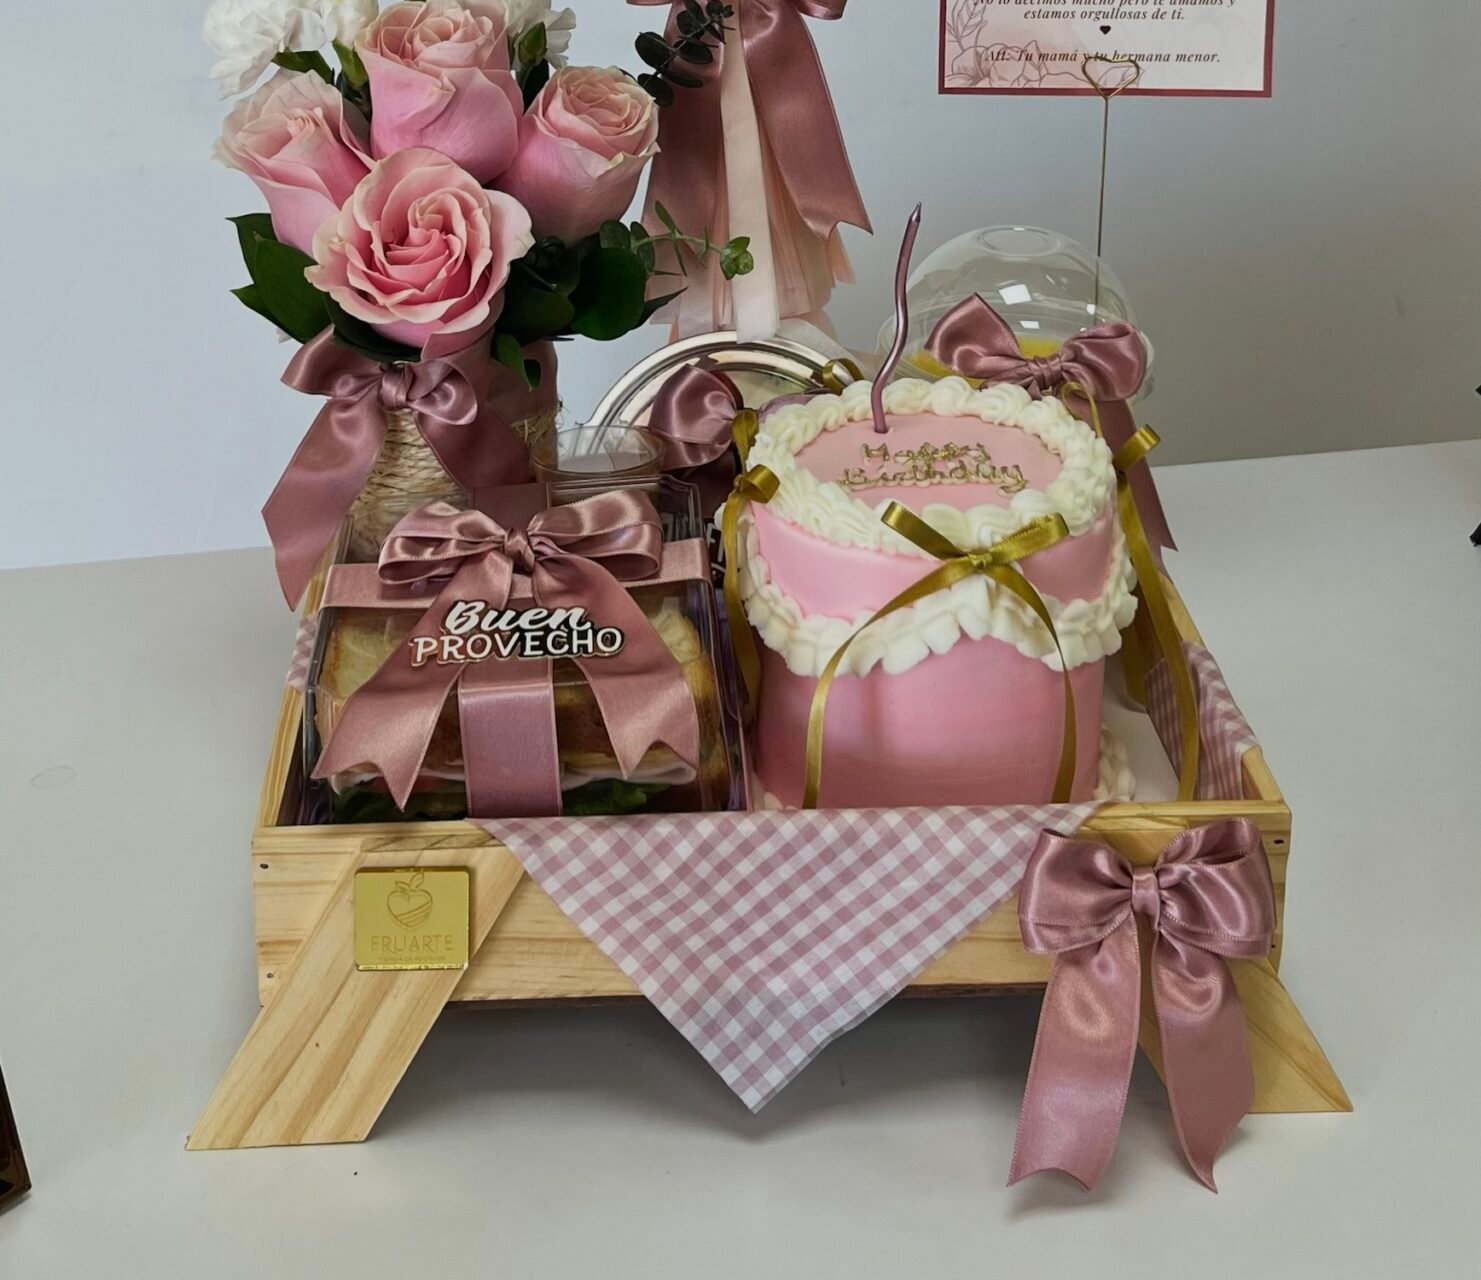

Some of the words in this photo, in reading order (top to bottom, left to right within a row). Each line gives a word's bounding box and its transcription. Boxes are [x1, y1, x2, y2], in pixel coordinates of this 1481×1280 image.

[1024, 8, 1076, 19] estamos
[1080, 8, 1147, 21] orgullosas
[1152, 8, 1168, 20] de
[1171, 9, 1184, 20] ti.
[1018, 50, 1032, 61] Tu
[1038, 50, 1078, 62] mamá
[1175, 53, 1220, 62] menor.
[445, 600, 592, 635] Buen
[413, 628, 622, 663] PROVECHO
[371, 934, 453, 954] FRUARTE
